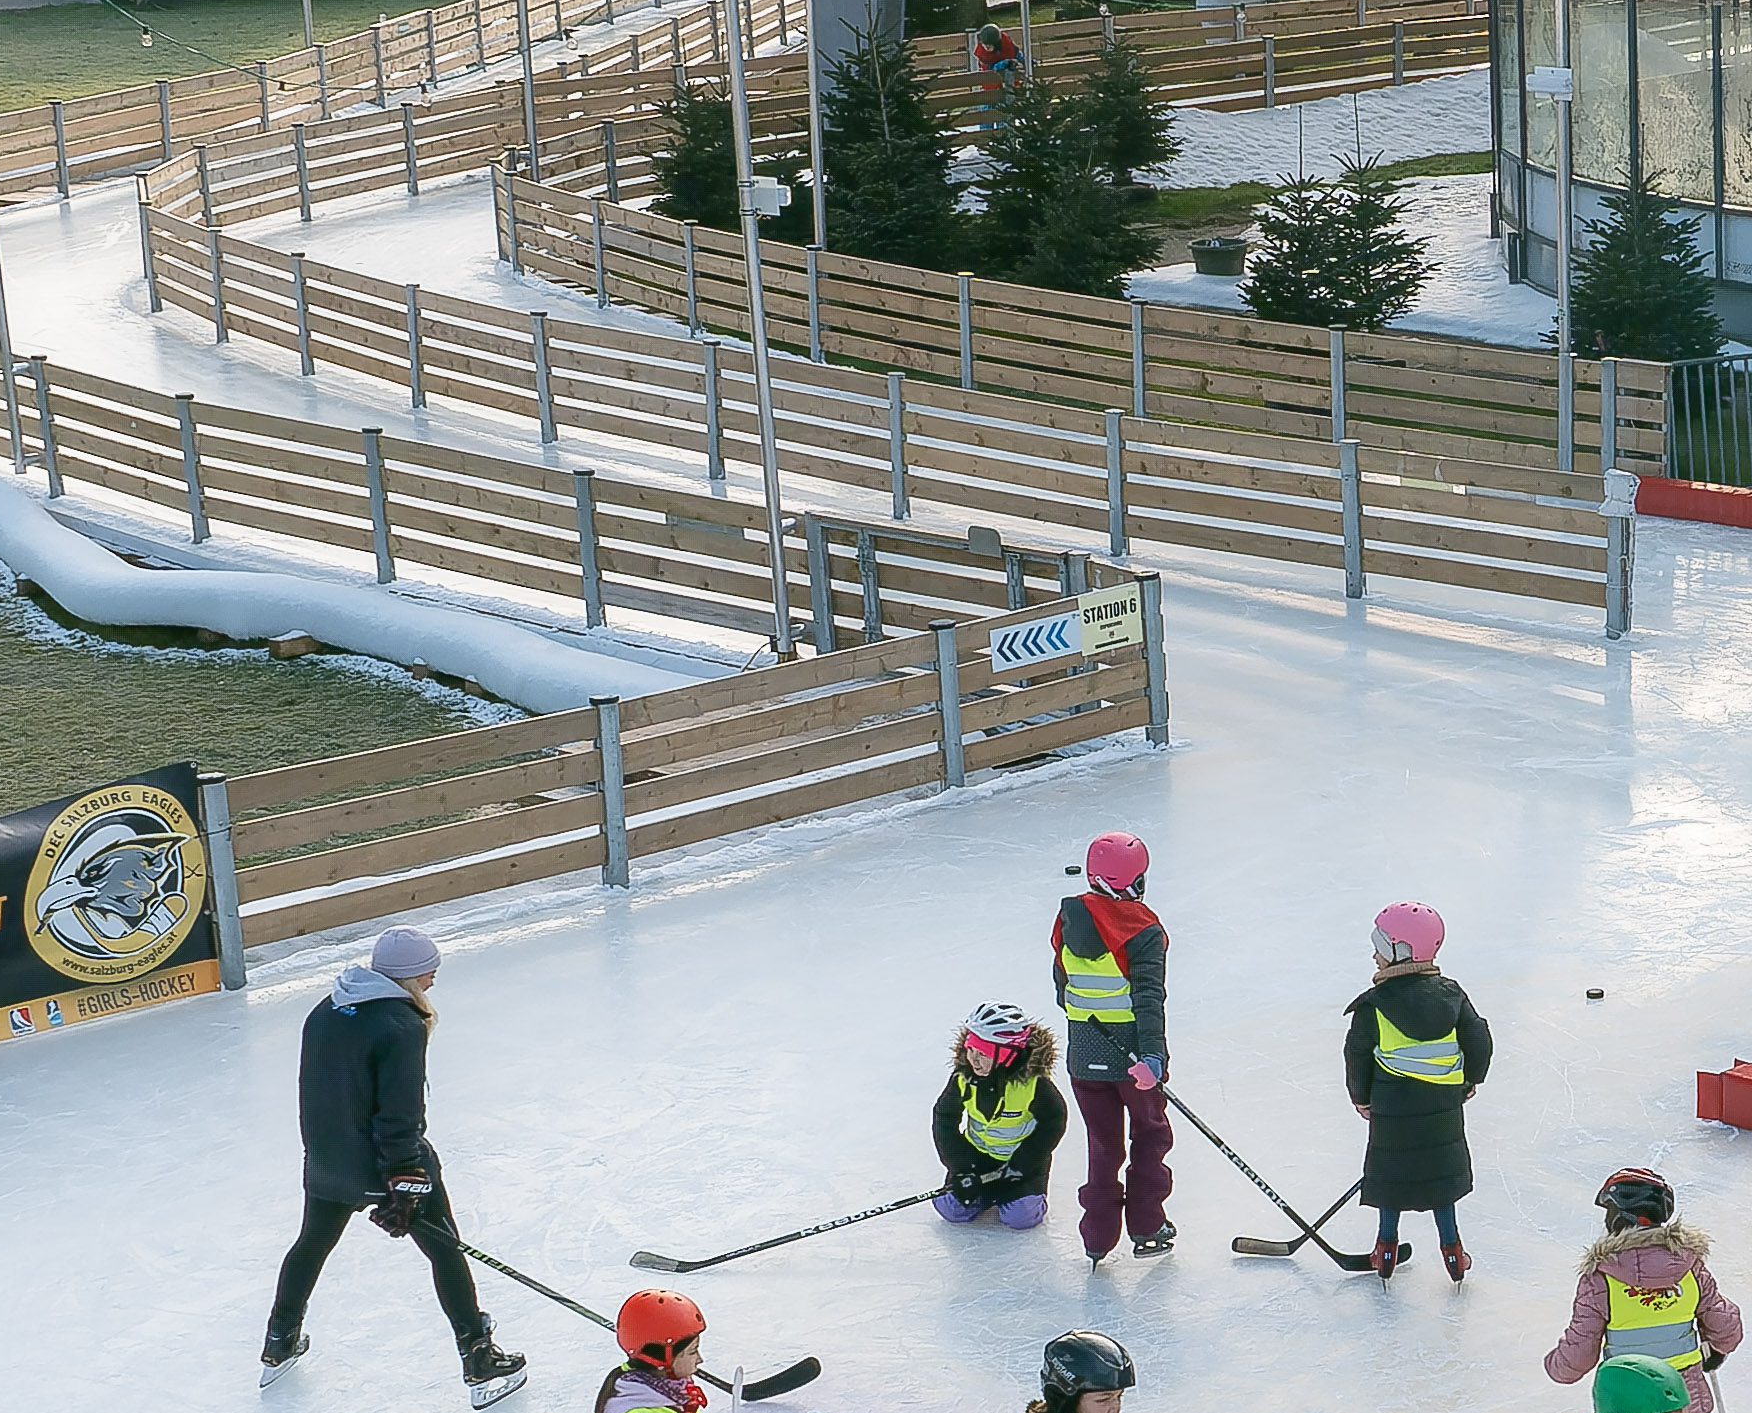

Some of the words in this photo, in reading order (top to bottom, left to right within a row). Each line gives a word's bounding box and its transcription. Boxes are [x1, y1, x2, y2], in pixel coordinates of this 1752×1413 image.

[1083, 599, 1127, 625] STATION
[1129, 597, 1137, 614] 6
[45, 830, 65, 859] DEC
[61, 790, 132, 827] SALZBURG
[142, 790, 183, 824] EAGLES
[61, 931, 178, 976] www.salzburg-eagles.at
[77, 972, 196, 1018] #GIRLS-HOCKEY
